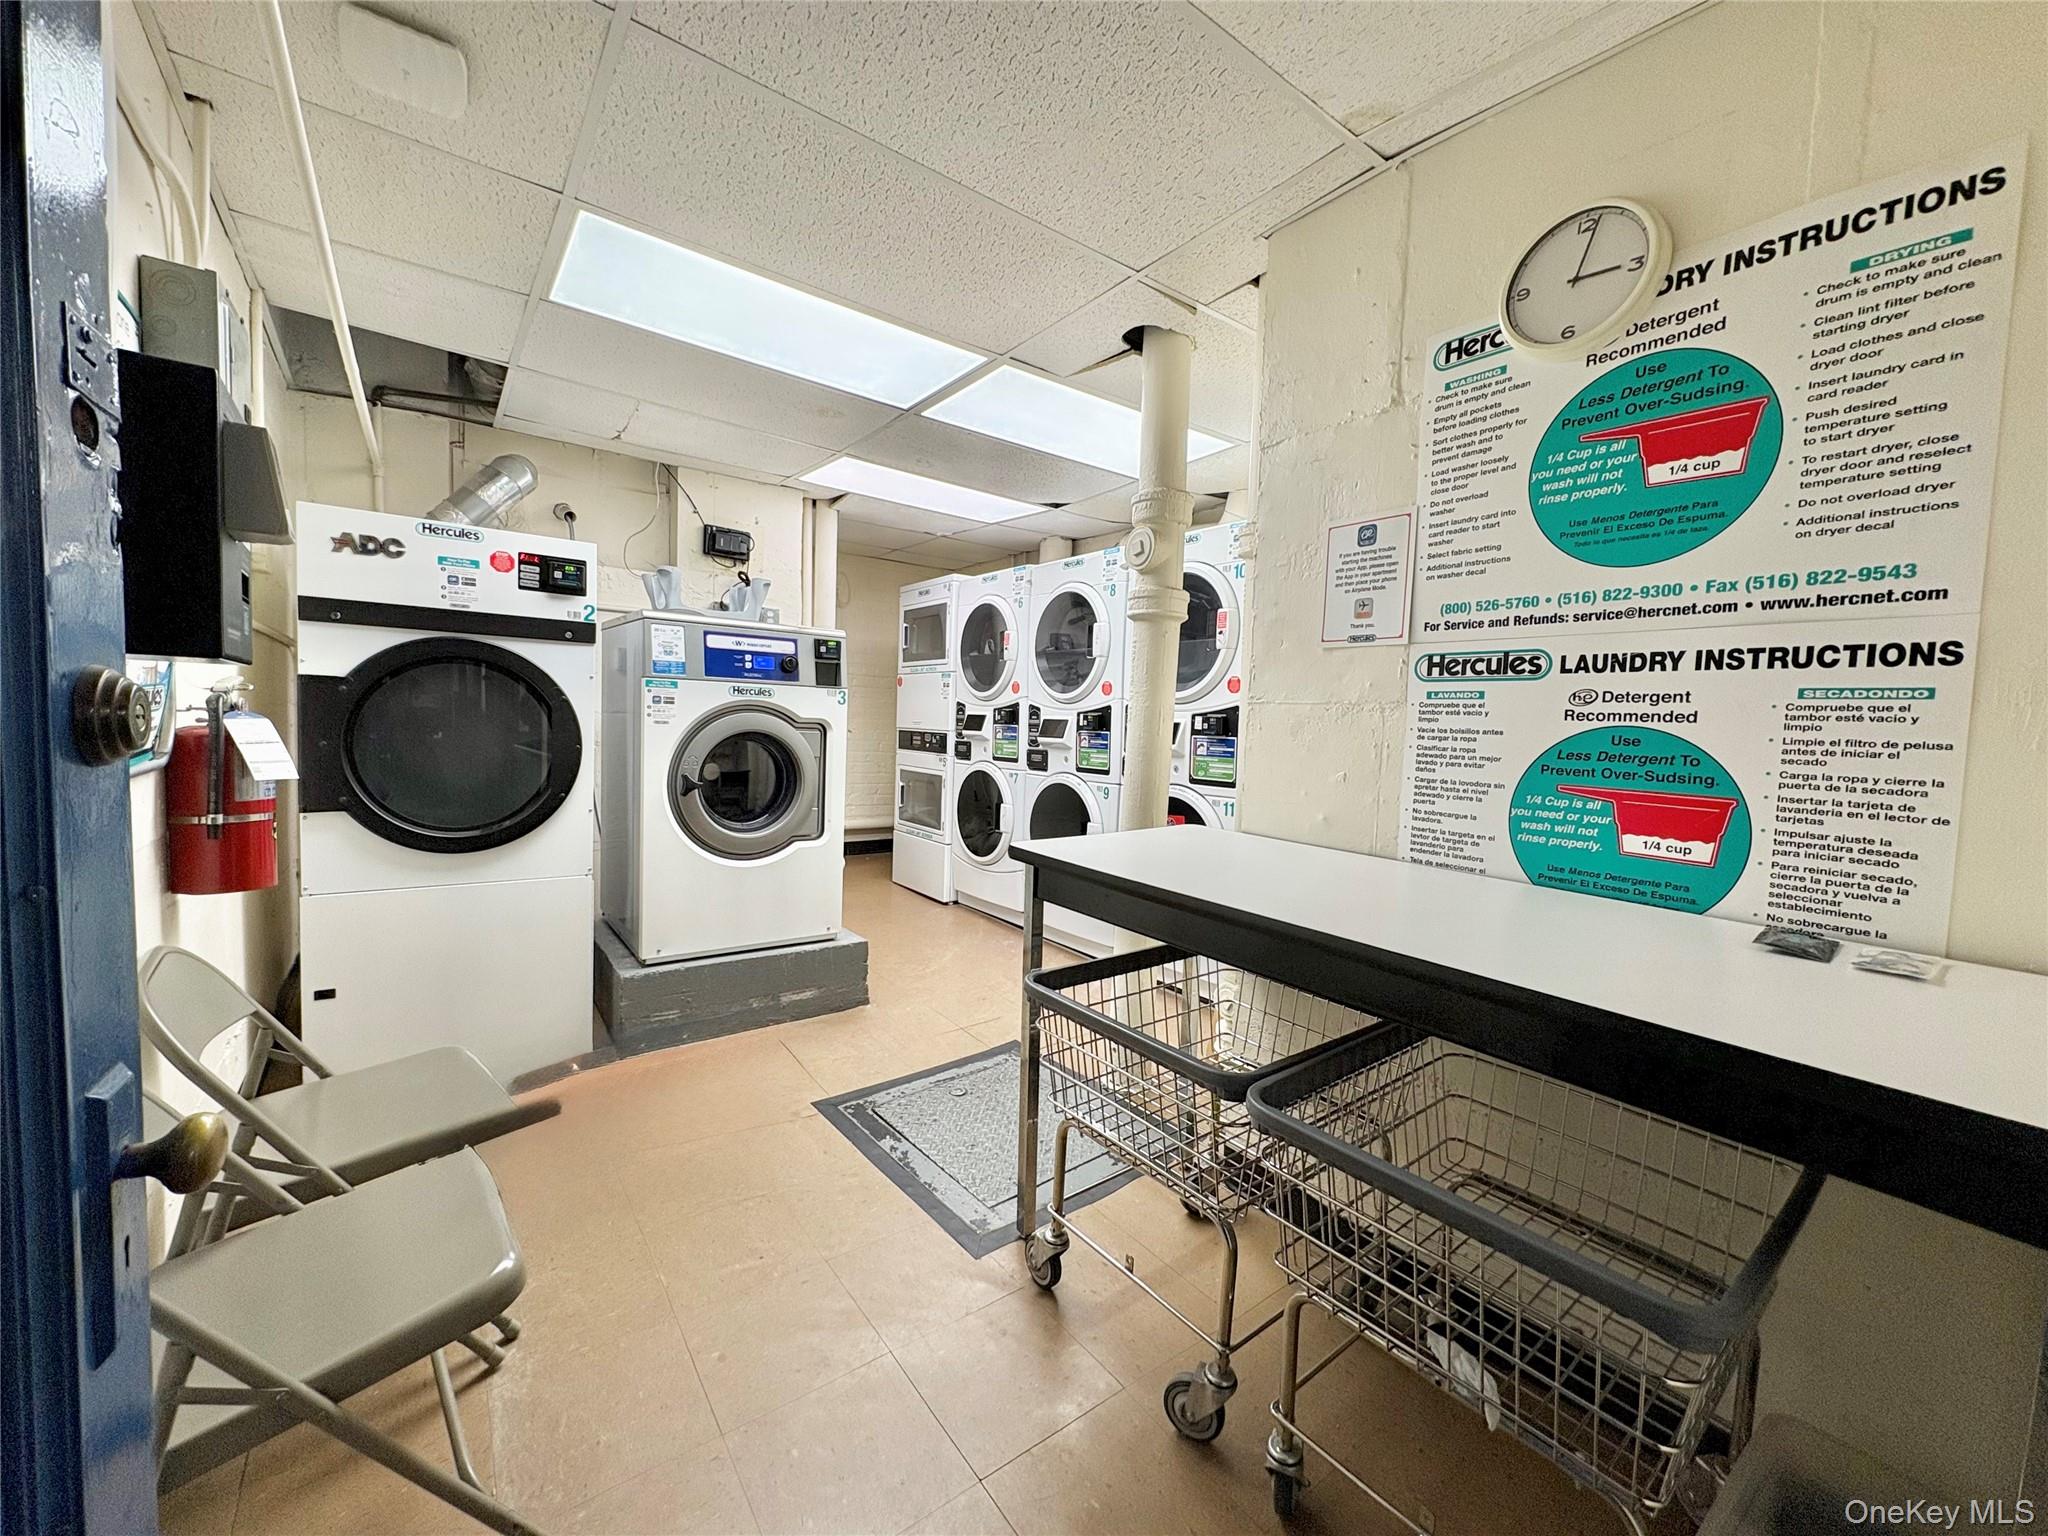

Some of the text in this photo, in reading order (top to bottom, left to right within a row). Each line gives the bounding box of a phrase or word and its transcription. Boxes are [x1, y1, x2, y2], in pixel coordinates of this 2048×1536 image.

[1577, 218, 1597, 235] 12
[1723, 166, 2006, 276] INSTRUCTIONS
[1869, 236, 1951, 266] DRYING
[1627, 256, 1645, 272] 3
[1816, 248, 1966, 295] Check to make sure
[1815, 253, 2002, 308] drum is empty and clean
[1516, 288, 1530, 302] 9
[1813, 280, 1975, 327] Clean lint filter before
[1561, 325, 1576, 340] 6
[1812, 309, 1910, 339] starting dryer
[1586, 315, 1727, 367] Recommended
[1449, 368, 1501, 389] WASHING
[1635, 362, 1667, 378] Use
[1808, 351, 1964, 390] Insert laundry card in
[1435, 376, 1513, 403] Check to make sure
[1578, 364, 1729, 410] Less Detergent To
[1561, 379, 1749, 430] Prevent Over-Sudsing.
[1547, 438, 1630, 464] 1/4 Cup is all
[1801, 433, 1959, 465] To restart dryer, close
[1530, 452, 1638, 482] you need or your
[1669, 459, 1721, 475] 1/4 cup
[1542, 468, 1623, 492] wash will not
[1429, 490, 1489, 508] Do not overload
[1538, 482, 1627, 505] rinse properly.
[1797, 481, 1956, 508] Do not overload dryer
[1795, 501, 1959, 526] Additional instructions
[422, 523, 481, 541] Hercules
[1794, 519, 1895, 539] on dryer decal
[331, 531, 406, 559] ADC
[1426, 544, 1502, 560] Select fabric setting
[1109, 583, 1117, 597] 8
[1440, 562, 1917, 617] (800) 526-5760 (516) 822-9300 Fax (516) 822-9543
[1018, 598, 1024, 609] 6
[1423, 588, 1949, 632] For Service and Refunds: service@hercnet.com www.hercnet.com
[583, 605, 596, 622] 2
[1426, 640, 1964, 678] Hercules LAUNDRY INSTRUCTIONS
[732, 686, 772, 697] Hercules
[838, 691, 846, 705] 3
[1601, 690, 1691, 706] Detergent
[1803, 689, 1929, 698] SECADONDO
[1564, 709, 1698, 724] Recommended
[1785, 702, 1911, 714] Compruebe que el
[1783, 722, 1823, 733] limpio
[1611, 734, 1641, 747] Use
[1556, 748, 1701, 767] Less Detergent To
[1780, 747, 1900, 759] antes de iniciar el
[1013, 773, 1019, 784] 7
[1540, 764, 1719, 789] Prevent Over-Sudsing.
[1103, 786, 1110, 799] 9
[1778, 782, 1929, 798] puerta de la secadora
[1223, 802, 1234, 817] 11
[1526, 794, 1605, 810] 1/4 Cup is all
[1510, 807, 1614, 824] you need or your
[1520, 821, 1598, 837] wash will not
[1517, 832, 1602, 852] rinse properly.
[1642, 840, 1692, 857] 1/4 cup
